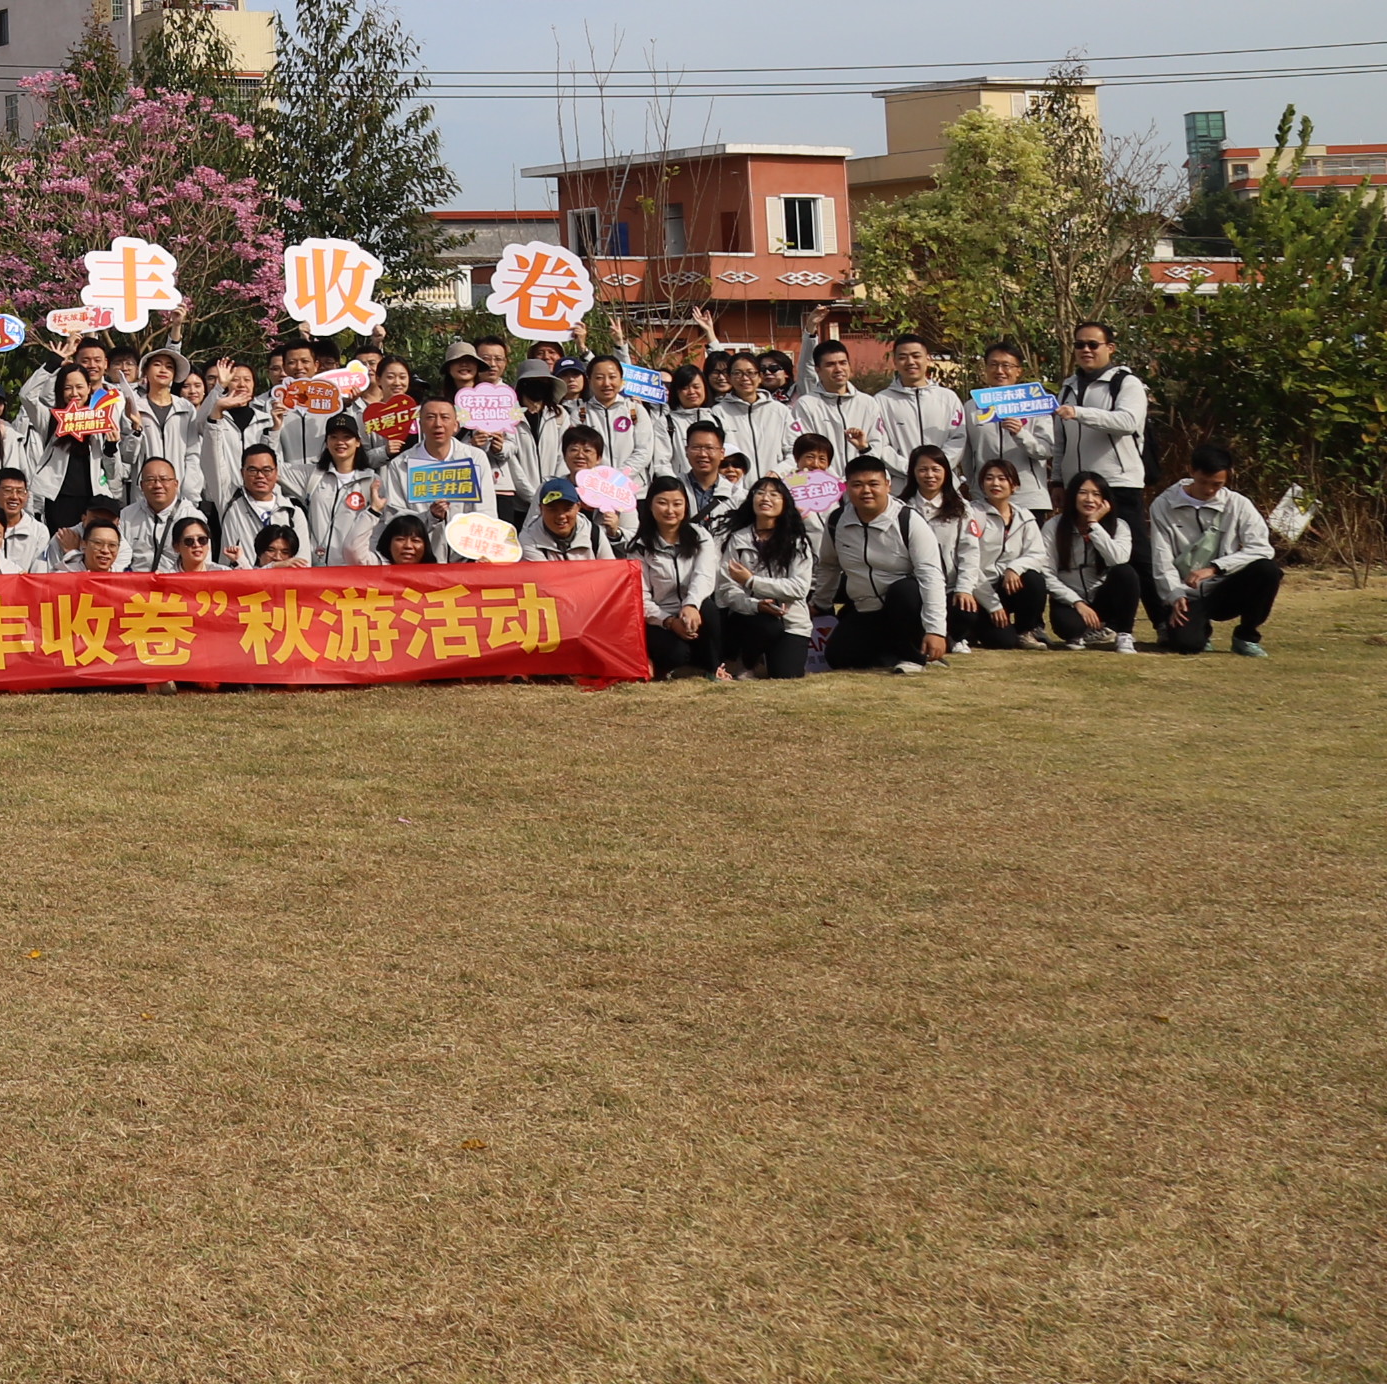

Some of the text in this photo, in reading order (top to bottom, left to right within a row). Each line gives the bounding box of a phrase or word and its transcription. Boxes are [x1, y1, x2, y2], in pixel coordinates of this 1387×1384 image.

[92, 247, 171, 322] 丰
[294, 248, 375, 325] 收
[499, 252, 582, 331] 卷
[461, 395, 512, 408] 花开万里
[470, 407, 509, 421] 恰如你
[618, 419, 628, 430] 4
[412, 467, 472, 483] 同心同德
[413, 482, 473, 497] 携手并肩
[586, 475, 633, 504] 美哒哒
[790, 481, 839, 500] 王在此
[350, 495, 360, 507] 8
[469, 522, 500, 541] 快乐
[459, 535, 507, 558] 丰收季
